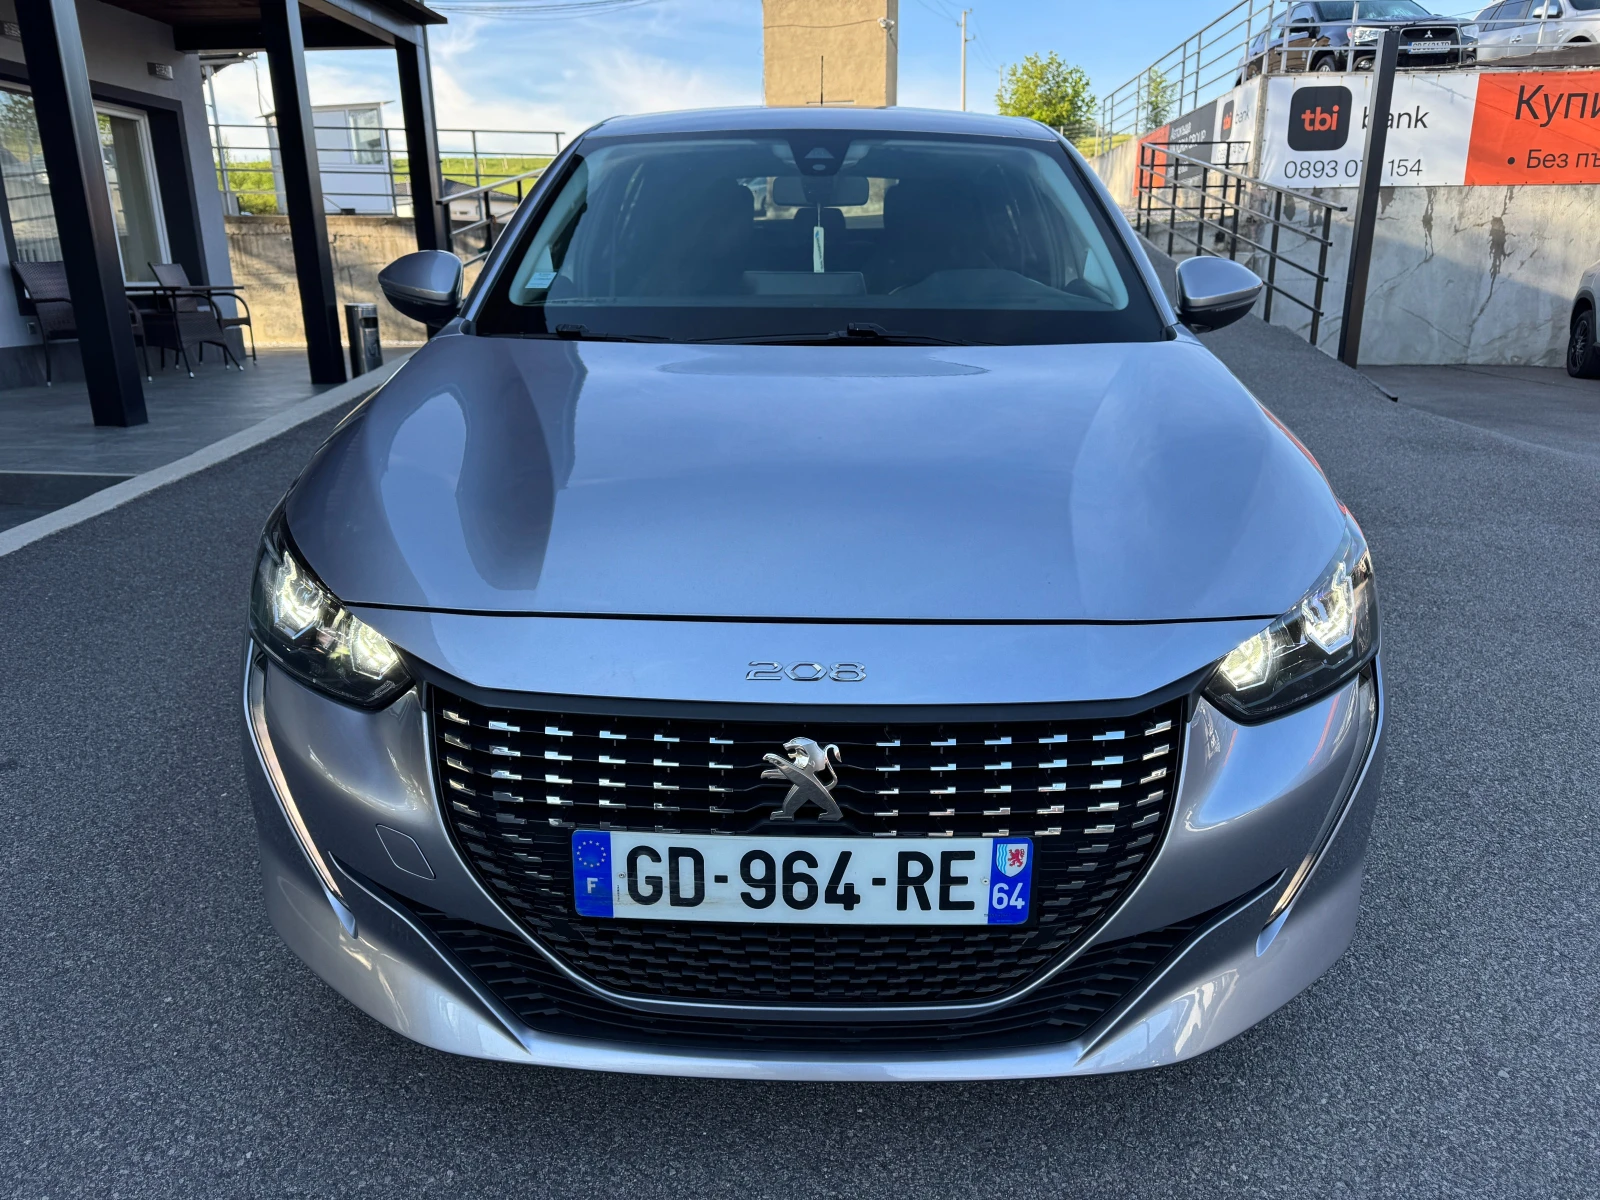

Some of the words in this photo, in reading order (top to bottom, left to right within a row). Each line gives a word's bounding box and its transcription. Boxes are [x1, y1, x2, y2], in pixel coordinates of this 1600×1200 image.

[1301, 104, 1340, 131] tbi
[1284, 160, 1339, 179] 0893
[1388, 158, 1423, 177] 154
[1526, 149, 1569, 169] Без
[746, 660, 867, 682] 208
[586, 877, 599, 894] F
[626, 845, 976, 911] GD-964-RE
[992, 882, 1026, 910] 64
